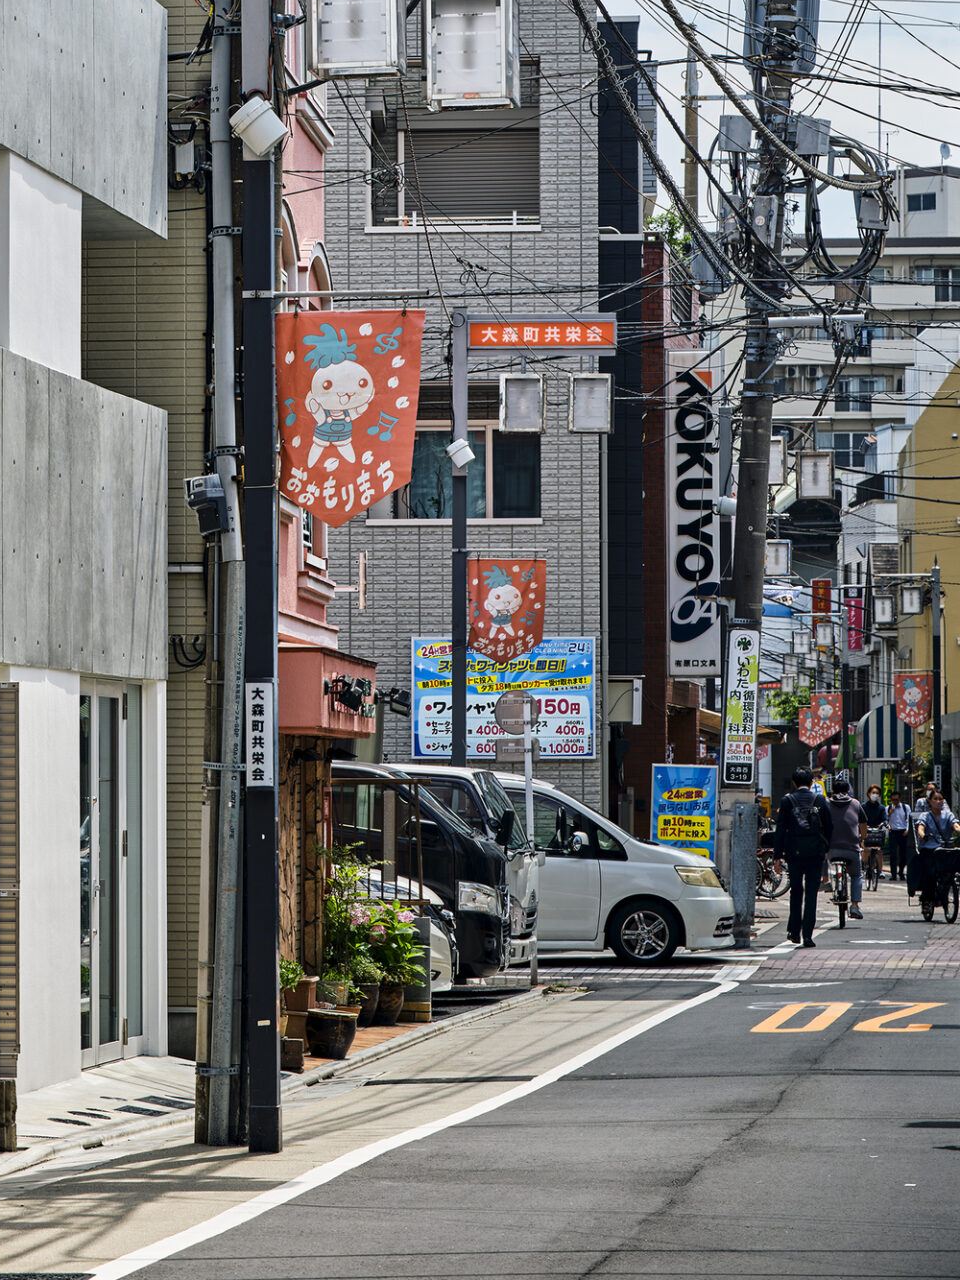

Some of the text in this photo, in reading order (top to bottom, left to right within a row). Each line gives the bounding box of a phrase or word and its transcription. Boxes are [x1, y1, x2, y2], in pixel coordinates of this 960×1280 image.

[481, 326, 603, 343] 大森町共栄会
[286, 460, 395, 512] おおもりまち
[676, 371, 714, 582] KOKUYO
[672, 595, 718, 624] OA
[473, 634, 535, 657] おおもりまち
[736, 656, 751, 689] いわた
[251, 687, 265, 781] 大森町共栄会
[555, 725, 585, 735] 400円
